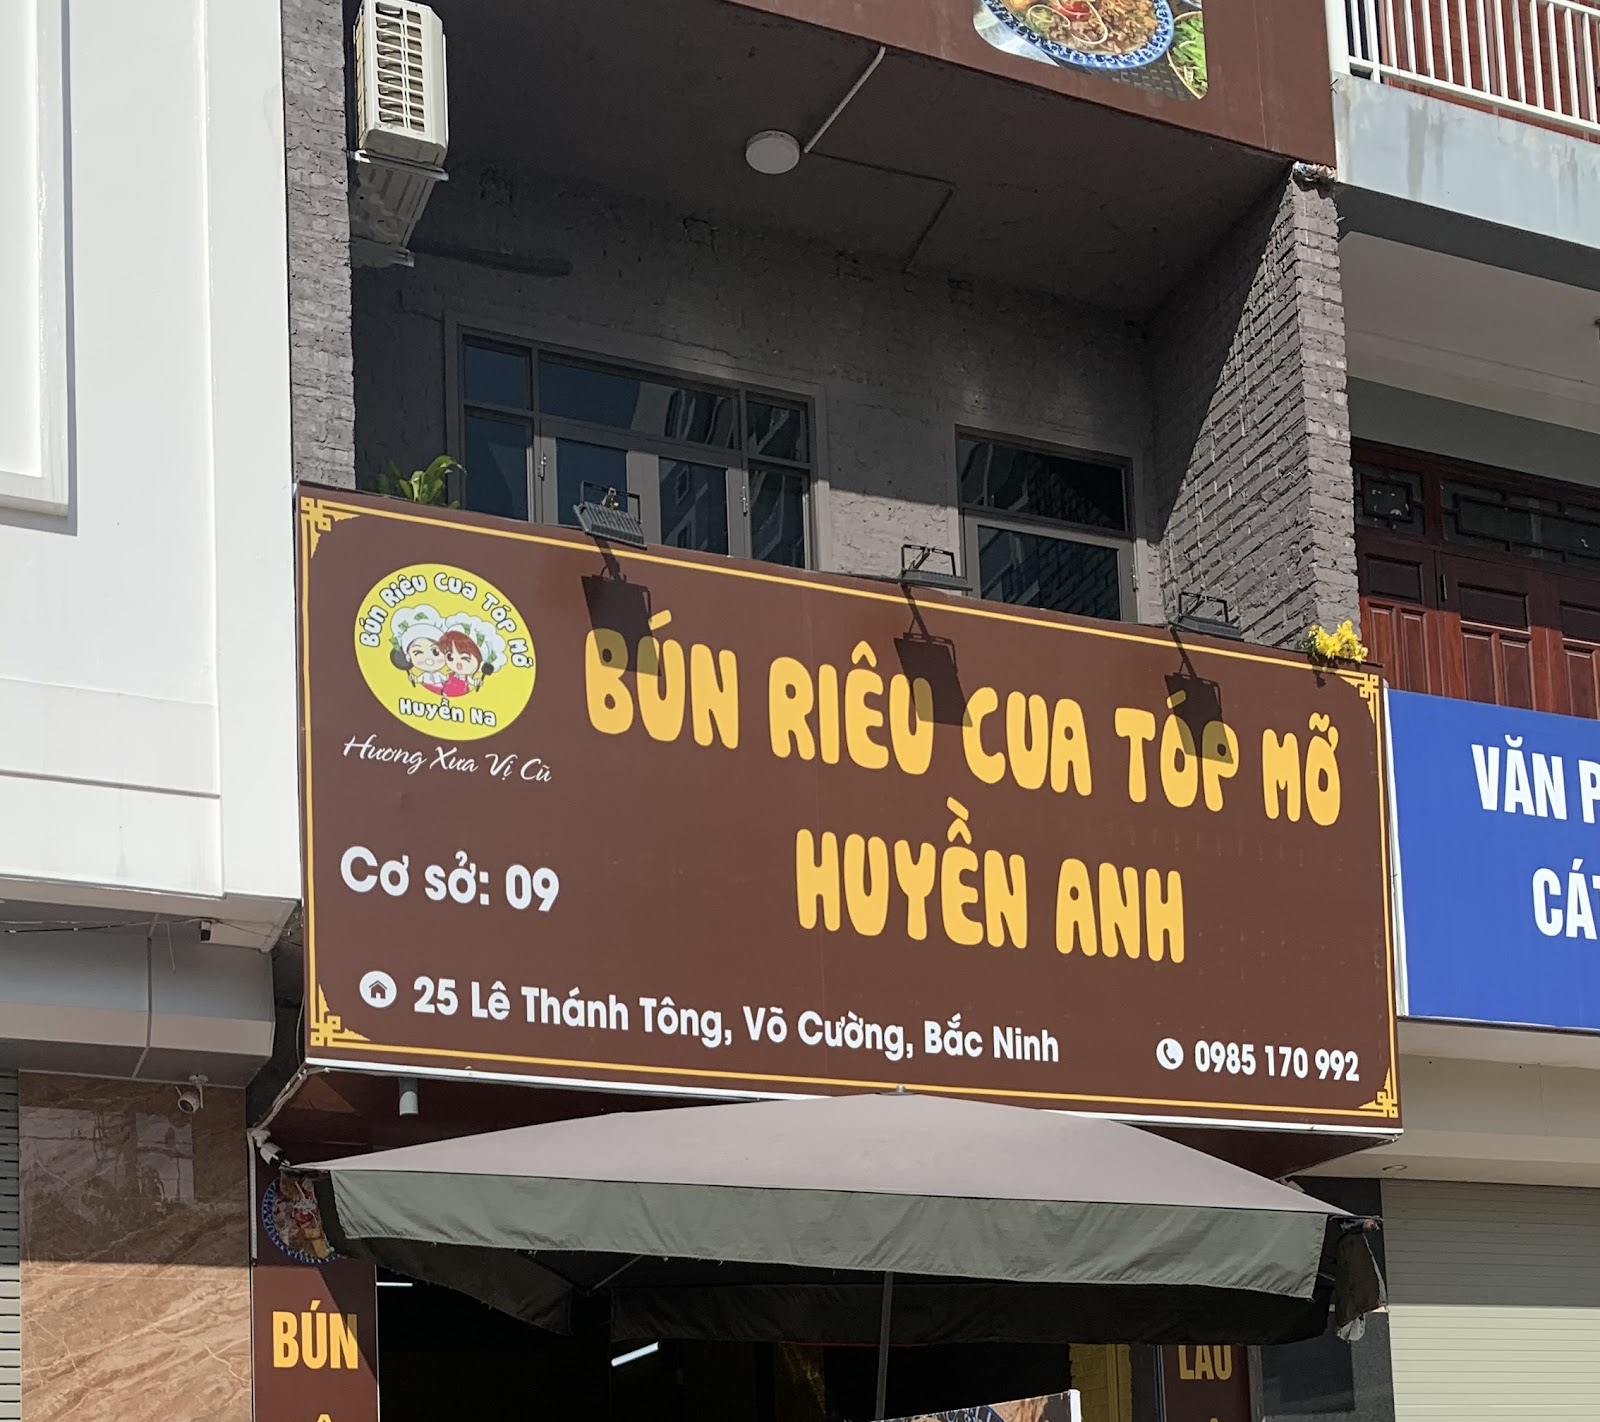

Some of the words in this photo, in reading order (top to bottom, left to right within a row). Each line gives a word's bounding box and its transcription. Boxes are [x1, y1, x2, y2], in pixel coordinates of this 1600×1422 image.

[359, 604, 389, 647] Bún
[379, 574, 427, 608] Riêu
[433, 572, 477, 600] Cua
[470, 707, 496, 727] Na
[584, 610, 739, 749] BÚN
[768, 640, 934, 775] RIÊU
[962, 687, 1092, 796] CUA
[1114, 690, 1240, 811] TÓP
[1262, 712, 1341, 826] MỠ
[343, 733, 427, 775] Hương
[429, 746, 479, 774] Xưa
[485, 753, 518, 781] Vị
[520, 757, 553, 783] Cũ
[1471, 734, 1567, 820] VĂN
[340, 845, 410, 897] Cơ
[424, 850, 490, 906] sở:
[505, 864, 560, 912] 09
[796, 796, 1028, 949] HUYỀN
[1056, 859, 1185, 963] ANH
[413, 975, 459, 1016] 25
[470, 980, 511, 1021] Lê
[520, 986, 629, 1032] Thánh
[638, 996, 733, 1049] Tông,
[742, 1005, 788, 1044] Võ
[797, 1010, 914, 1062] Cường,
[924, 1012, 984, 1058] Bắc
[993, 1025, 1060, 1063] Ninh
[1194, 1040, 1257, 1076] 0985
[1264, 1045, 1309, 1079] 170
[1314, 1048, 1360, 1082] 992
[272, 1300, 359, 1370] BÚN
